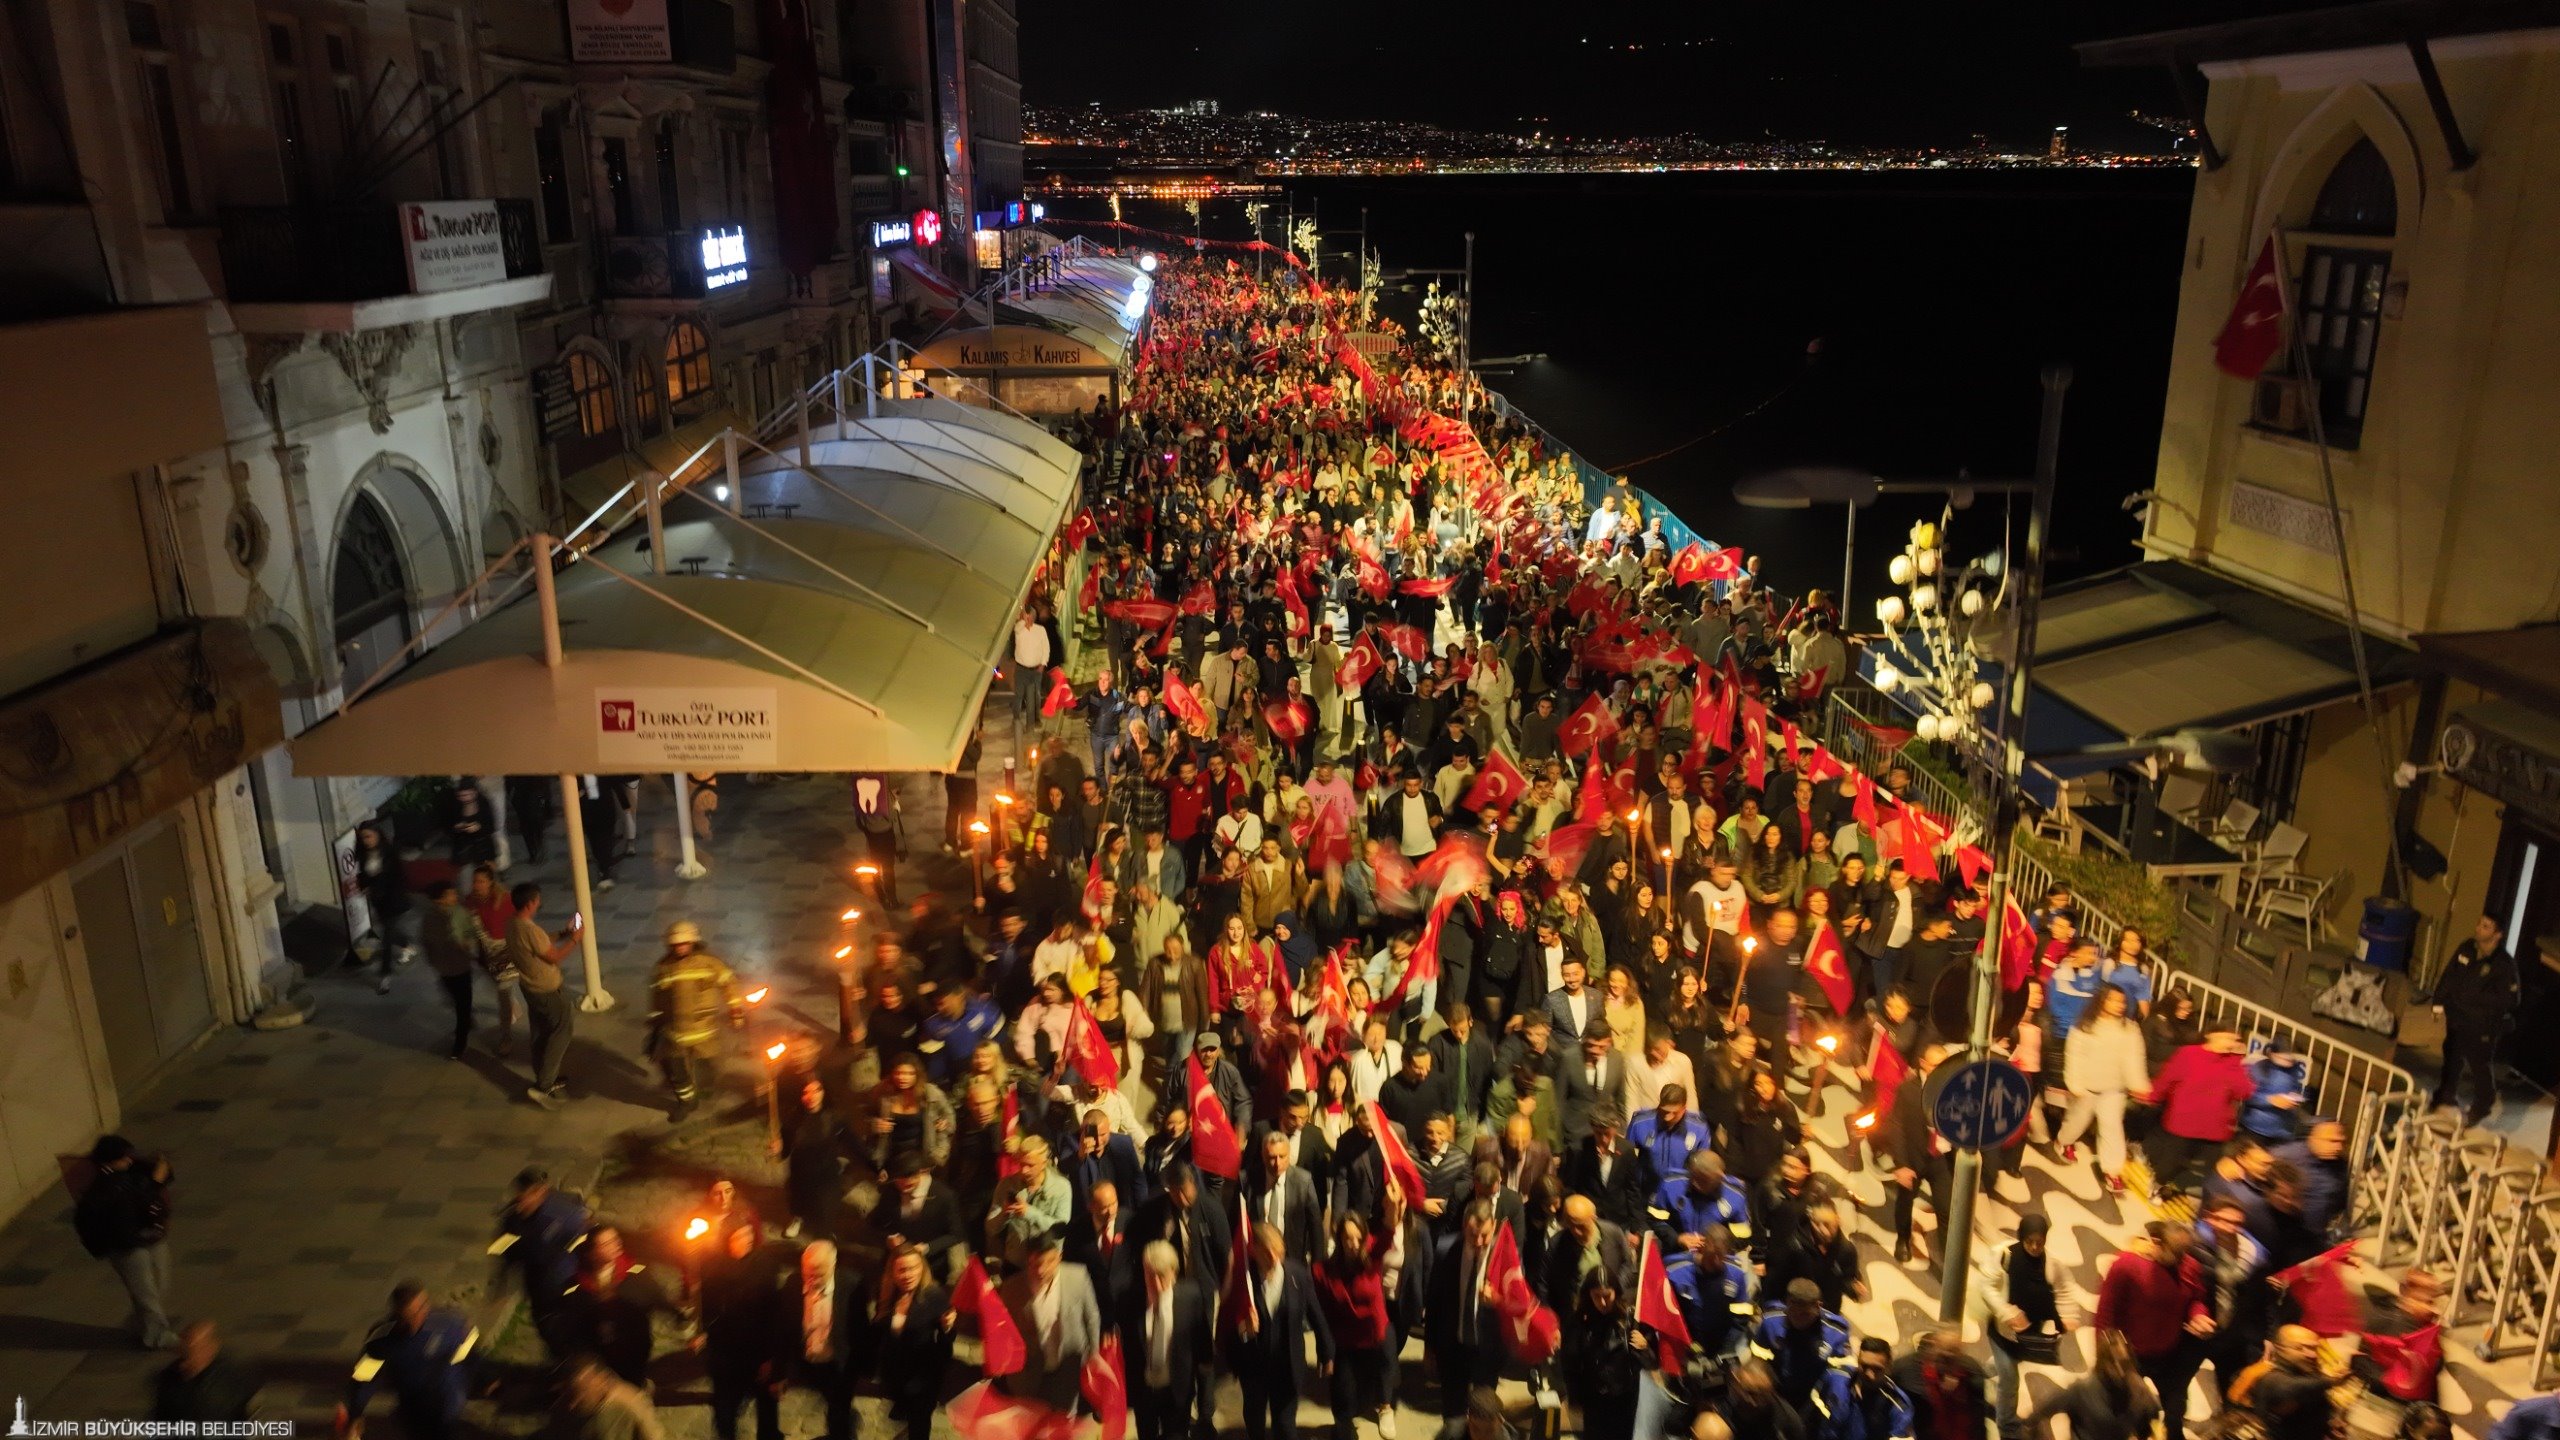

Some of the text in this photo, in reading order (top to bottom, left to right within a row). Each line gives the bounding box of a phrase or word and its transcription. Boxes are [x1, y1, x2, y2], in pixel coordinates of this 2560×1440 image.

[960, 345, 1080, 366] KALAMIŞ KAHVESİ
[637, 709, 713, 726] TURKUAZ
[658, 731, 669, 740] VE
